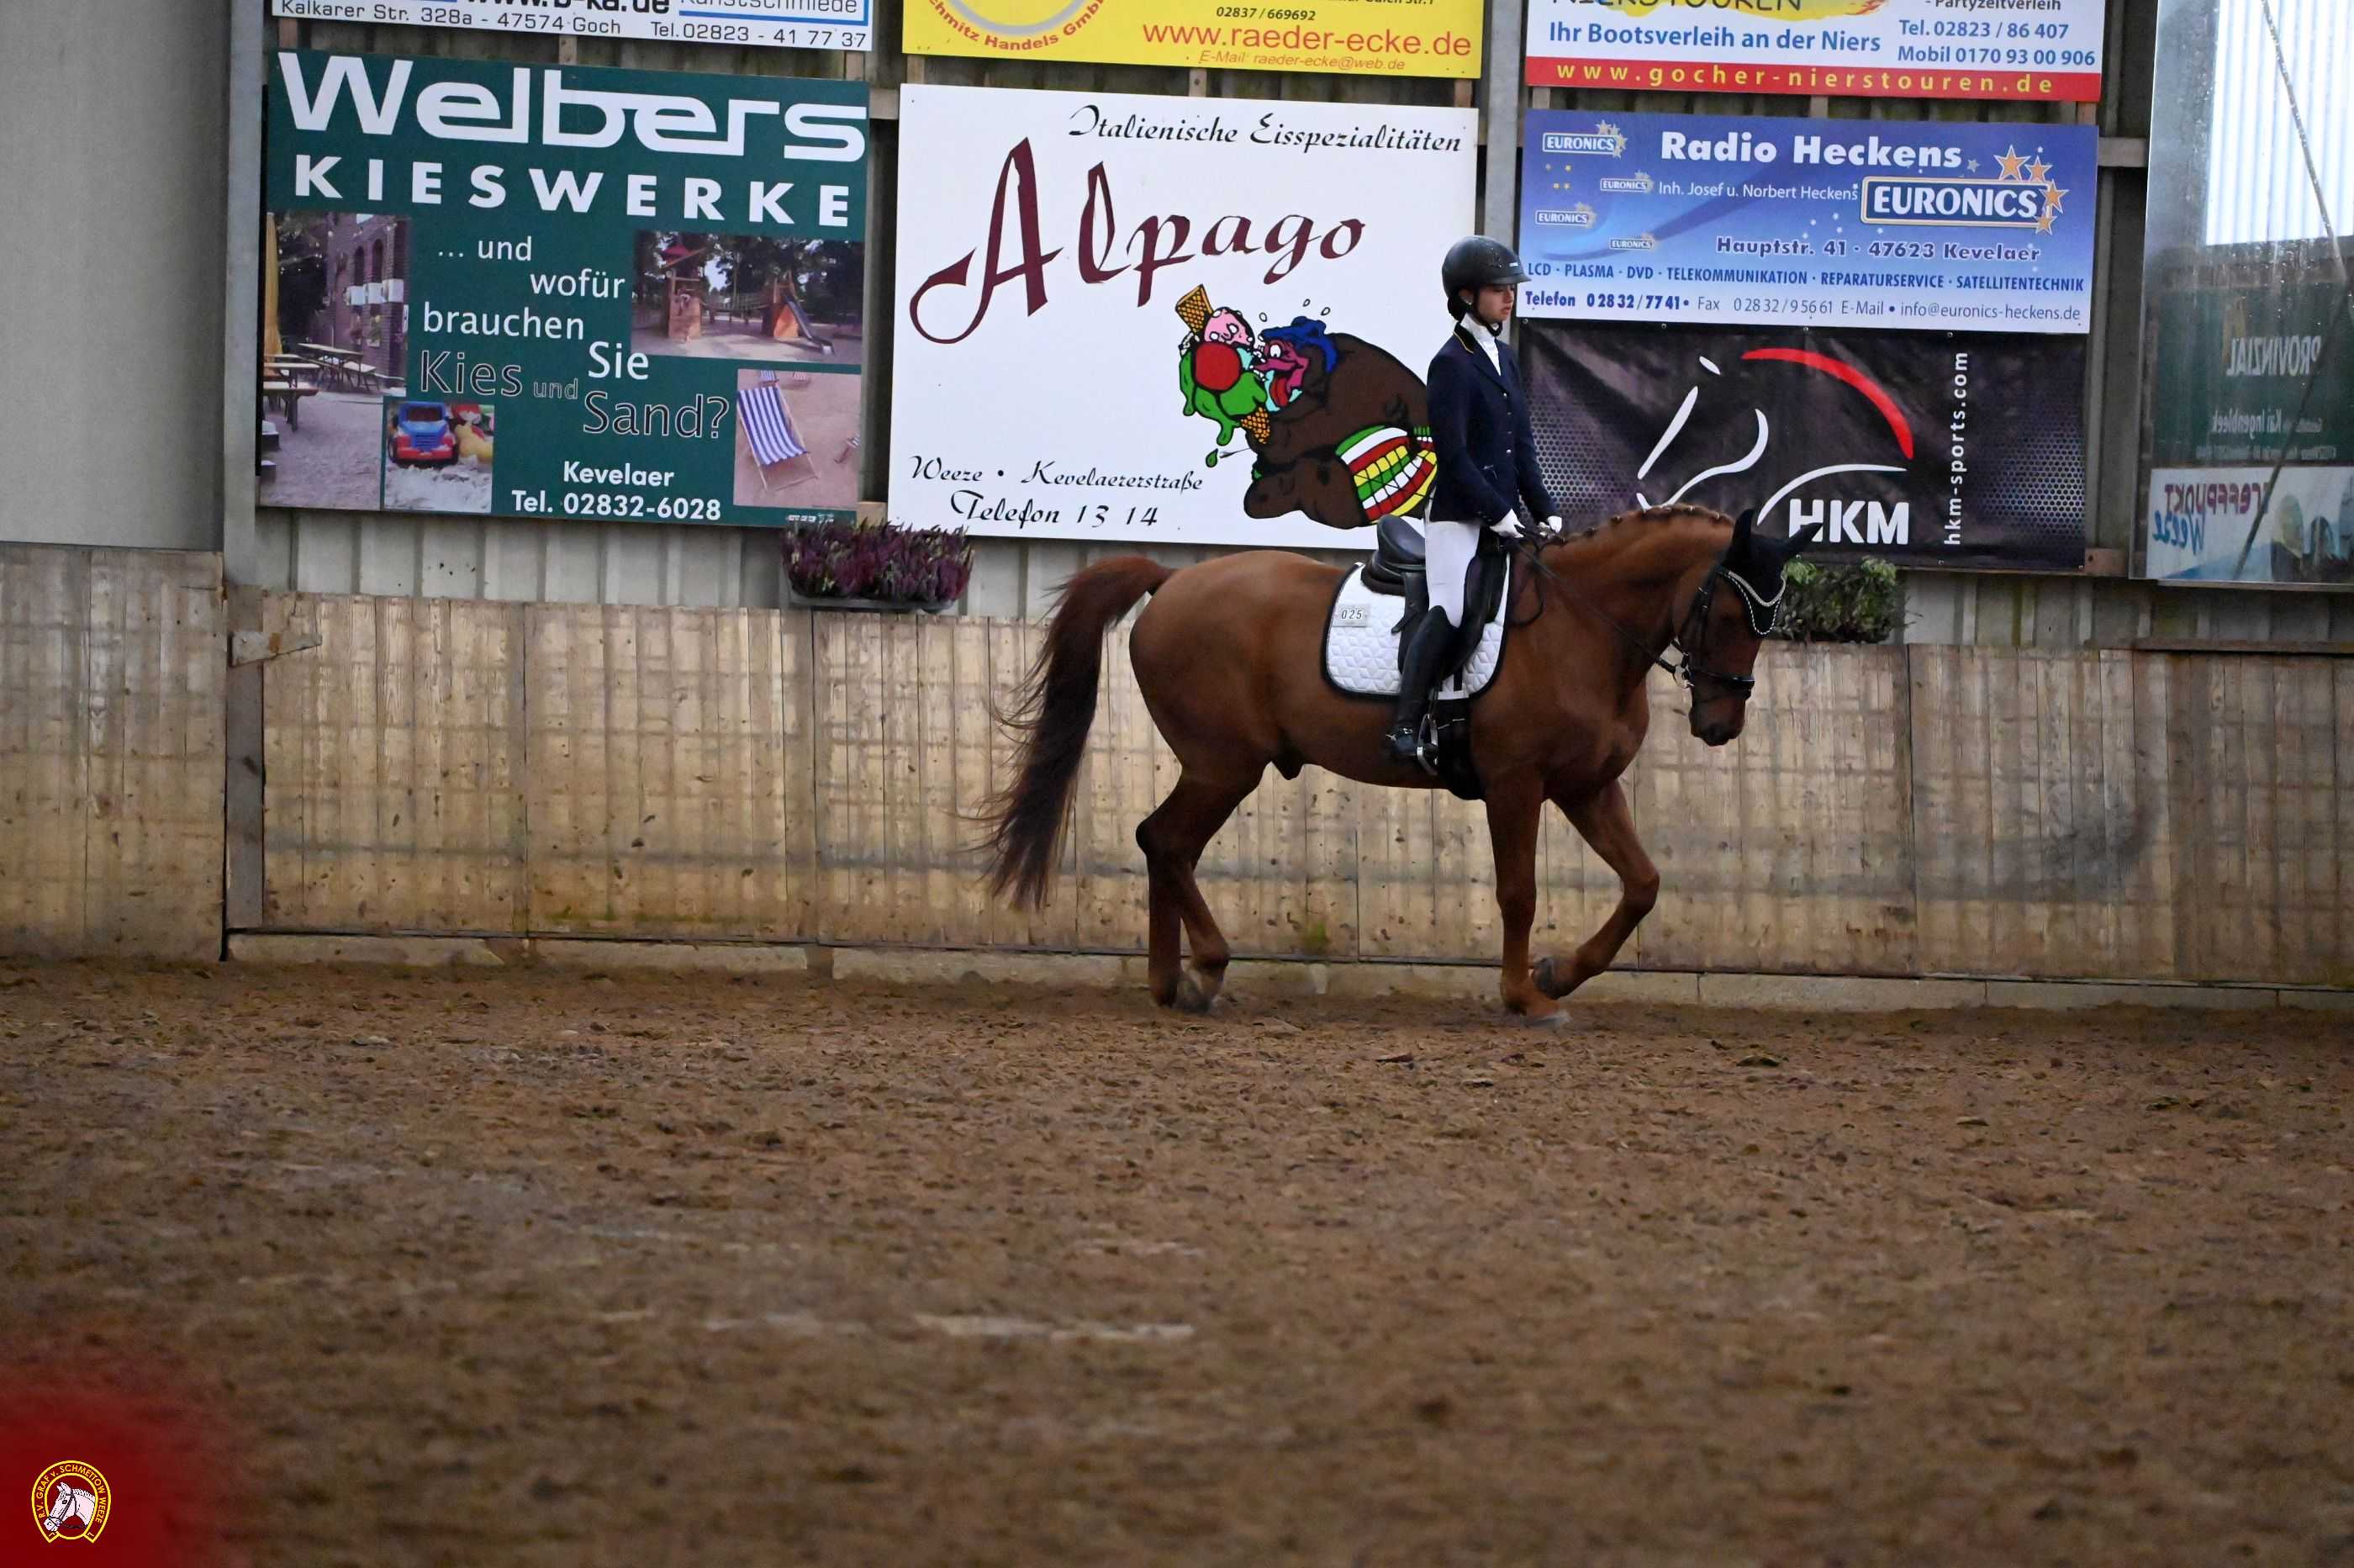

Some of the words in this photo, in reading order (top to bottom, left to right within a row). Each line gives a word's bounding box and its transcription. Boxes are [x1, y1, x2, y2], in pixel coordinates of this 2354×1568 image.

[681, 0, 857, 13] sschmiede
[1216, 6, 1257, 18] 02837
[1267, 8, 1317, 21] 669692
[282, 0, 365, 18] Kalkarer
[373, 5, 409, 21] Str.
[420, 8, 472, 25] 328a
[497, 13, 564, 30] 47574
[573, 17, 620, 34] Goch
[651, 21, 679, 38] Tel.
[684, 23, 749, 42] 02823
[773, 29, 796, 45] 41
[808, 30, 832, 46] 77
[842, 32, 866, 48] 37
[928, 0, 980, 41] chmitz
[984, 34, 1059, 50] Handels
[1063, 0, 1103, 36] Gmb
[1549, 21, 1581, 41] Ihr
[1588, 23, 1734, 47] Bootsverleih
[1741, 33, 1769, 48] an
[1776, 29, 1815, 50] der
[1821, 30, 1881, 52] Niers
[1898, 19, 1930, 36] Tel.
[1934, 20, 1990, 38] 02823
[2007, 23, 2029, 39] 86
[2035, 24, 2069, 40] 407
[1143, 24, 1472, 56] www.raeder-ecke.de
[1897, 45, 1950, 63] Mobil
[1955, 47, 2001, 64] 0170
[2006, 49, 2028, 65] 93
[2033, 50, 2056, 65] 00
[2061, 50, 2096, 66] 906
[1253, 55, 1405, 71] raeder-ecke@web.de
[1557, 64, 2052, 93] www.gocher-nierstouren.de
[278, 52, 867, 162] Welbers
[1069, 104, 1238, 144] Italienische
[1249, 112, 1463, 153] Eisspezialitäten
[1546, 136, 1615, 151] EURONICS
[1661, 131, 1776, 163] Radio
[1793, 135, 1961, 167] Heckens
[294, 154, 850, 227] KIESWERKE
[1602, 181, 1647, 190] EURONICS
[1659, 182, 1684, 195] Inh.
[1687, 182, 1724, 197] Josef
[1727, 187, 1738, 197] u.
[1743, 183, 1796, 199] Norbert
[1801, 186, 1858, 200] Heckens
[1873, 186, 2037, 218] EURONICS
[1539, 213, 1587, 223] EURONICS
[478, 235, 532, 261] und
[909, 136, 1365, 344] Alpago
[1717, 237, 1814, 256] Hauptstr.
[1824, 241, 1845, 256] 41
[1869, 242, 1934, 258] 47623
[1944, 244, 2040, 261] Kevelaer
[530, 268, 625, 298] wofür
[1528, 262, 1551, 276] LCD
[1565, 264, 1614, 278] PLASMA
[1627, 266, 1654, 279] DVD
[1667, 267, 1808, 284] TELEKOMMUNIKATION
[1821, 272, 1944, 288] REPARATURSERVICE
[1956, 275, 2084, 292] SATELLITENTECHNIK
[424, 303, 584, 340] brauchen
[1525, 291, 1575, 307] Telefon
[1697, 296, 1720, 311] Fax
[1841, 300, 1884, 315] E-Mail
[1901, 302, 2081, 321] info@euronics-heckens.de
[420, 350, 523, 396] Kies
[532, 377, 578, 399] und
[588, 341, 650, 380] Sie
[583, 391, 730, 439] Sand?
[1944, 352, 1968, 545] hkm-sports.com
[563, 461, 674, 487] Kevelaer
[909, 456, 983, 482] Weeze
[1021, 461, 1203, 494] Kevelaererstraße
[512, 490, 554, 514] Tel.
[563, 493, 721, 521] 02832-6028
[950, 489, 1059, 529] Telefon
[1788, 499, 1909, 545] HKM
[1341, 610, 1363, 619] 025
